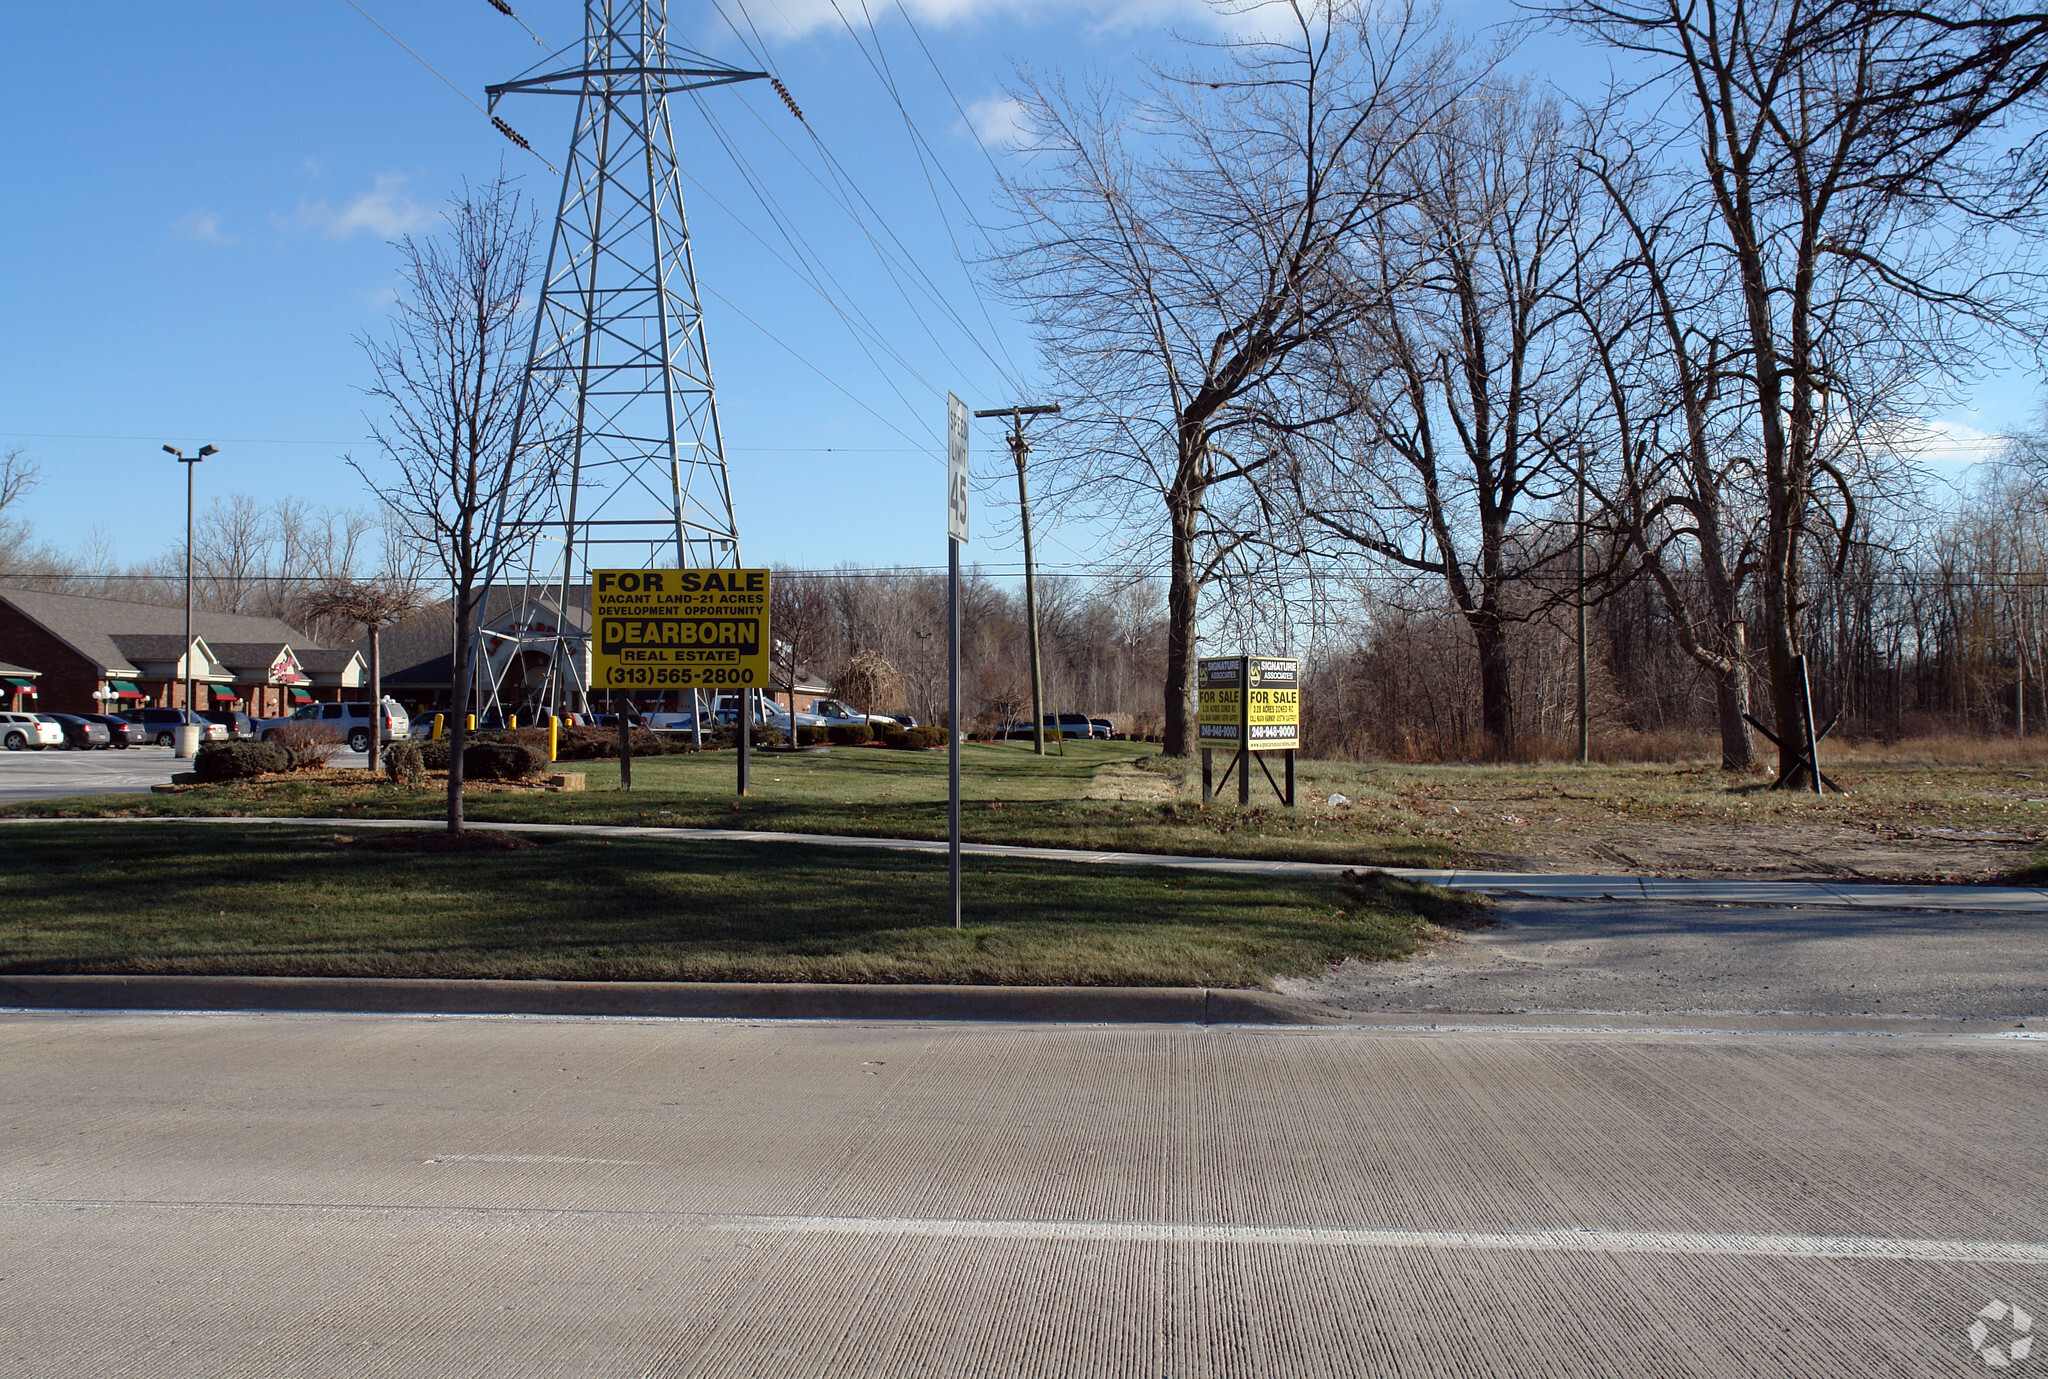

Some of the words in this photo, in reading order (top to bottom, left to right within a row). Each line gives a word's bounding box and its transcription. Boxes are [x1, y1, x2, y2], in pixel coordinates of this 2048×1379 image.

[950, 410, 968, 441] SPEED
[951, 439, 966, 468] LIMIT
[950, 471, 967, 525] 45
[599, 573, 664, 592] FOR
[681, 573, 764, 592] SALE
[599, 594, 652, 604] VACANT
[657, 594, 714, 604] LAND-21
[719, 594, 764, 604] ACRES
[598, 606, 679, 616] DEVELOPMENT
[684, 606, 764, 616] OPPORTUNITY
[605, 622, 755, 644] DEARBORN
[624, 651, 668, 661] REAL
[675, 651, 736, 661] ESTATE
[1207, 659, 1240, 671] SIGNATURE
[1261, 661, 1297, 671] SIGNATURE
[606, 666, 754, 685] (313)565-2800
[1210, 670, 1237, 680] ASSOCIATES
[1264, 671, 1294, 680] ASSOCIATES
[1199, 691, 1216, 703] FOR
[1218, 690, 1239, 703] SALE
[1250, 691, 1269, 704] FOR
[1273, 691, 1297, 704] SALE
[1263, 705, 1275, 714] ACRES
